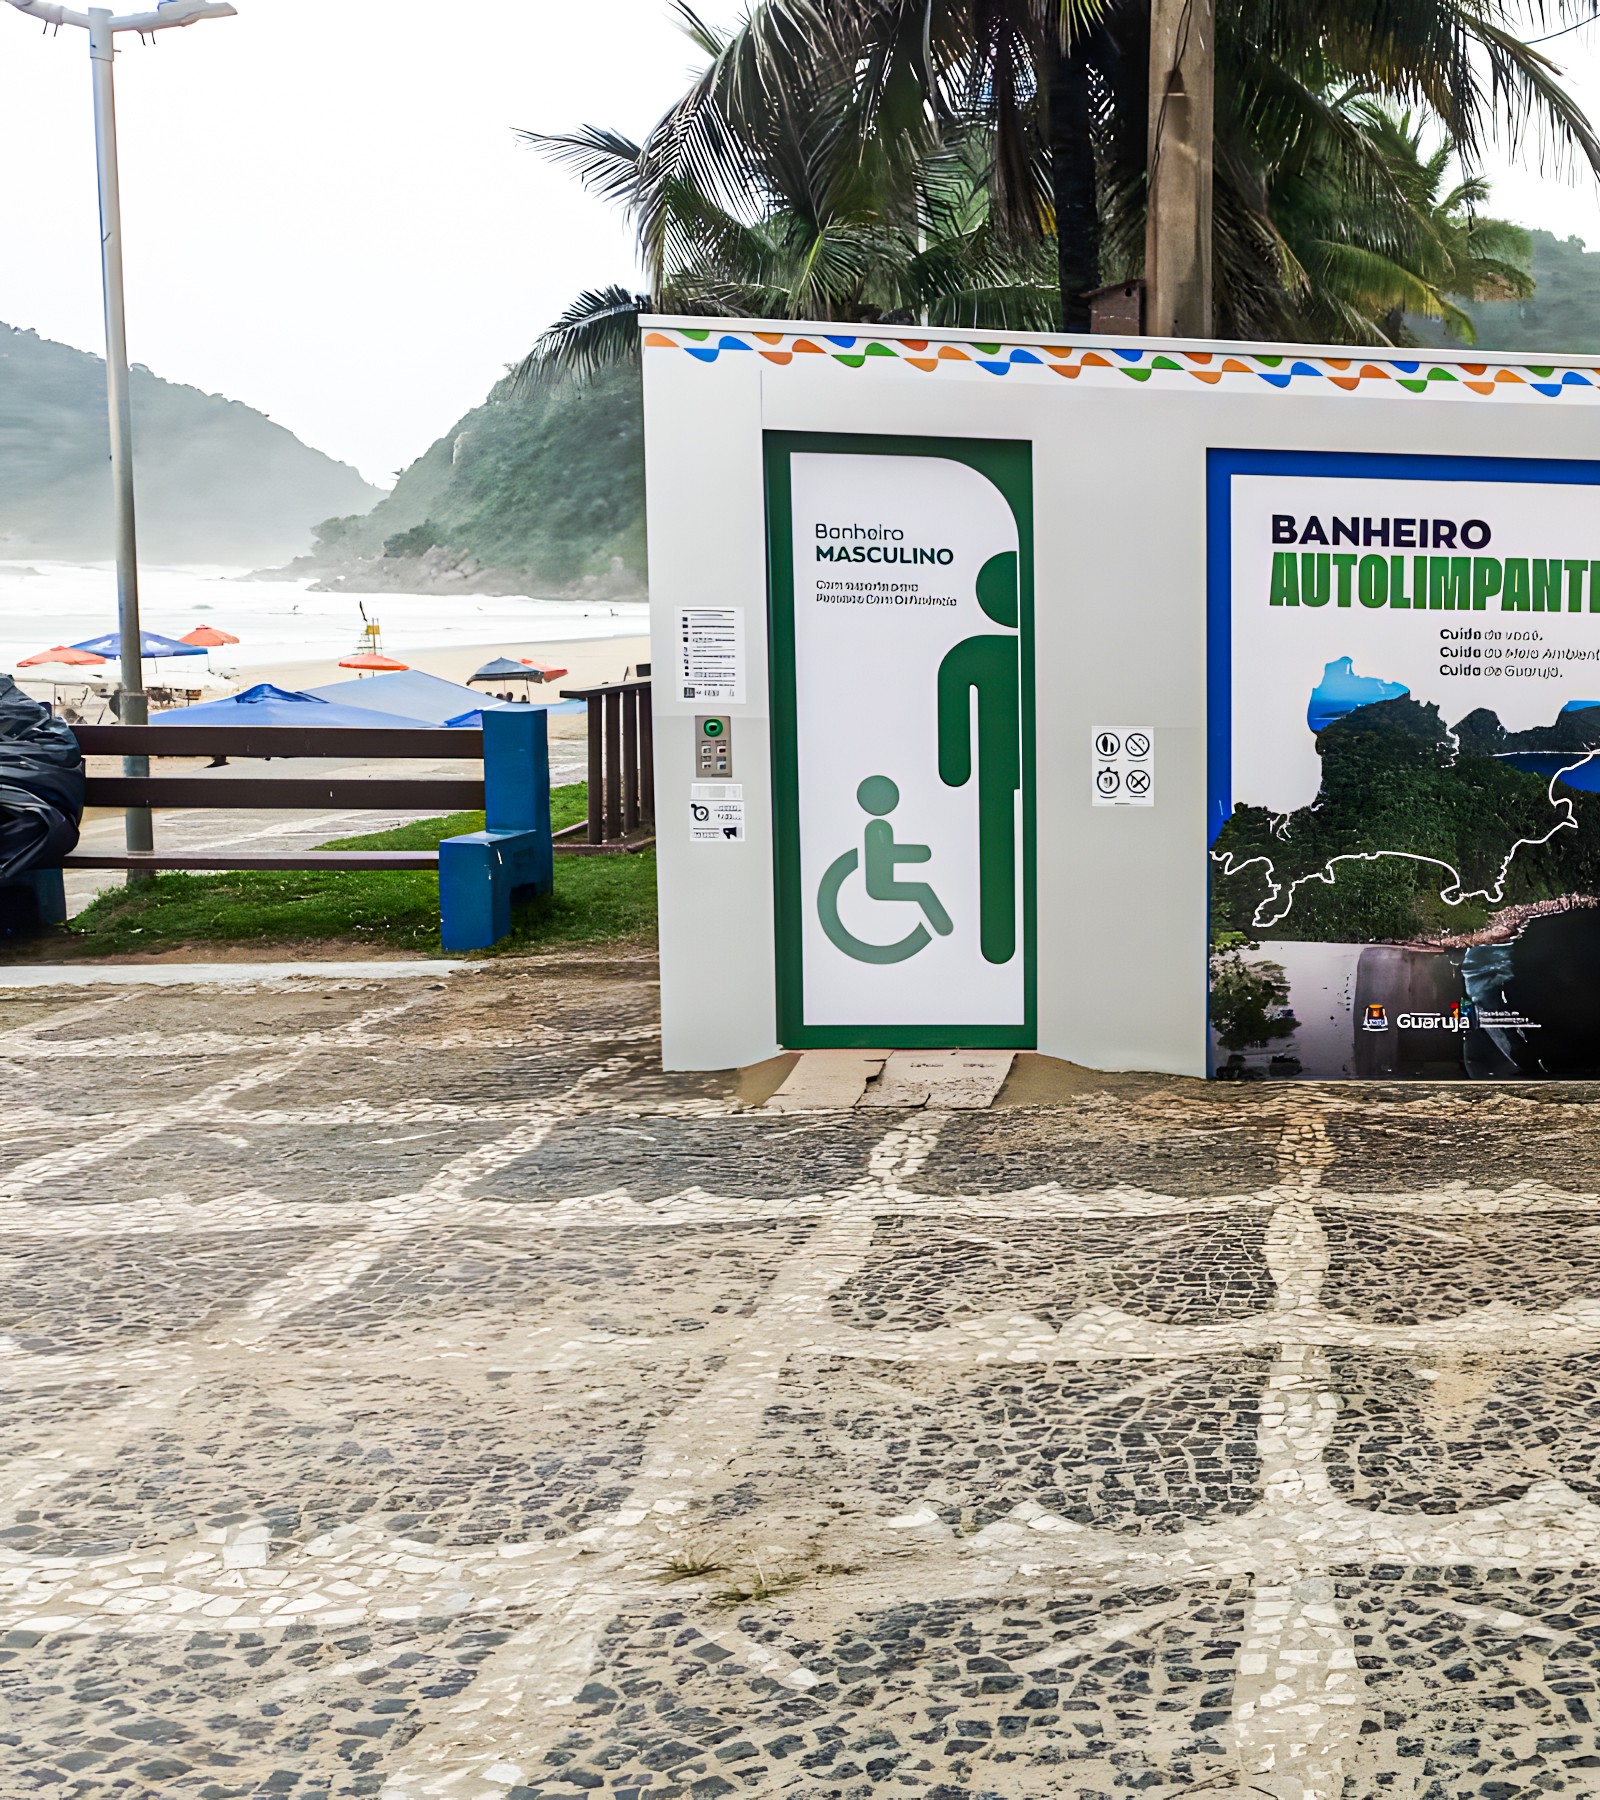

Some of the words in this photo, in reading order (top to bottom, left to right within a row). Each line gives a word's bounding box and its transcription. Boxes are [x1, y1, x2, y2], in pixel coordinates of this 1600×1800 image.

[815, 523, 904, 541] Banheiro
[1271, 513, 1492, 550] BANHEIRO
[815, 545, 954, 566] MASCULINO
